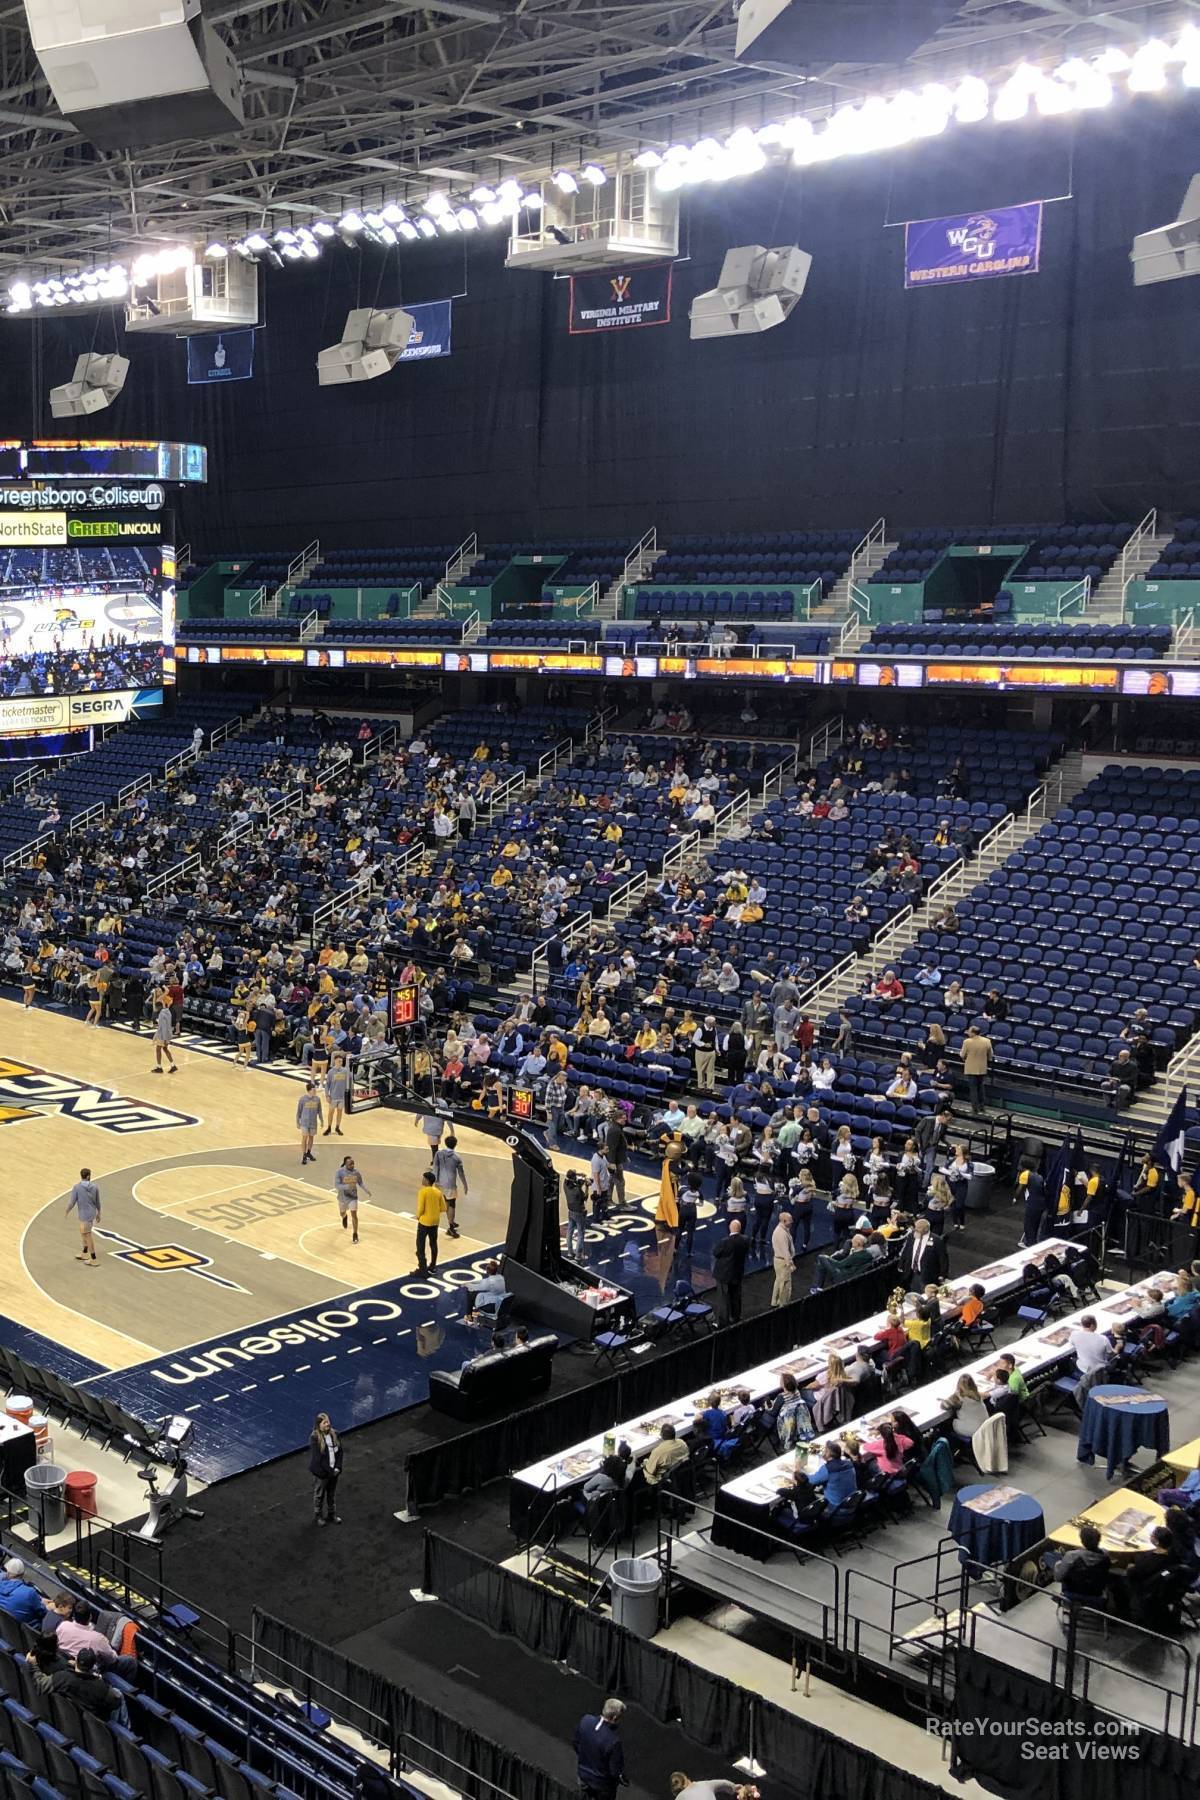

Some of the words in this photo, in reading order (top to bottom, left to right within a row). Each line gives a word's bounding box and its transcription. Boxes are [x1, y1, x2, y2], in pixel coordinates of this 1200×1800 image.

[948, 229, 994, 258] WCU
[910, 264, 967, 281] WESTERN
[969, 256, 1030, 273] CAROLINA
[580, 307, 617, 319] VIRGINIA
[618, 301, 660, 315] MILITARY
[596, 314, 642, 327] INSTITUTE
[92, 486, 162, 505] Coliseum
[2, 704, 57, 718] ticketmaster
[72, 699, 125, 715] SEGRA
[394, 1001, 412, 1024] 30
[515, 1102, 529, 1114] 30
[186, 1183, 333, 1231] SOCON
[151, 1298, 402, 1386] Coliseum
